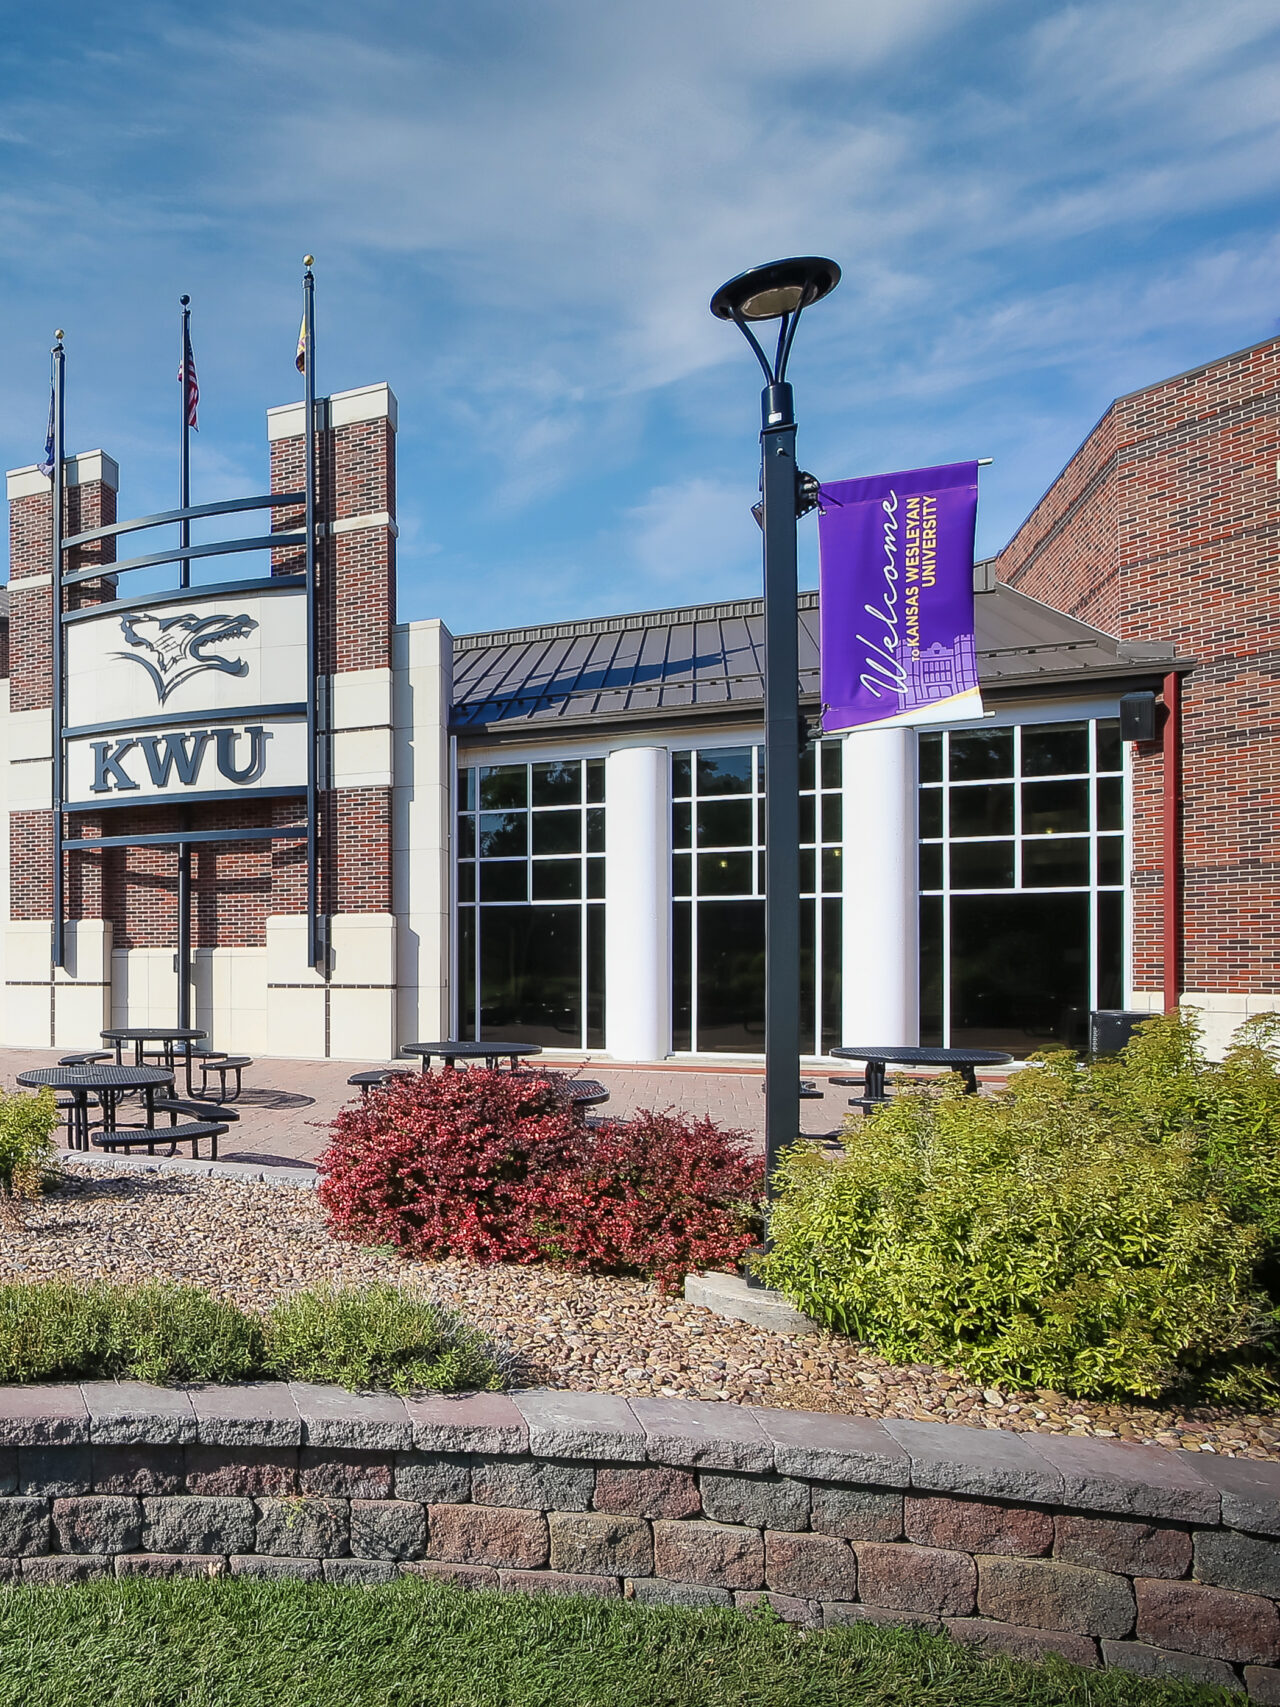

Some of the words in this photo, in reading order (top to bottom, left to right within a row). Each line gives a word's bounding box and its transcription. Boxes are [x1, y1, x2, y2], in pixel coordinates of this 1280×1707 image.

[906, 497, 921, 583] WESLEYAN
[921, 495, 937, 587] UNIVERSITY
[856, 489, 909, 698] Welcome
[905, 585, 920, 647] KANSAS
[911, 649, 920, 662] TO
[89, 726, 274, 793] KWU
